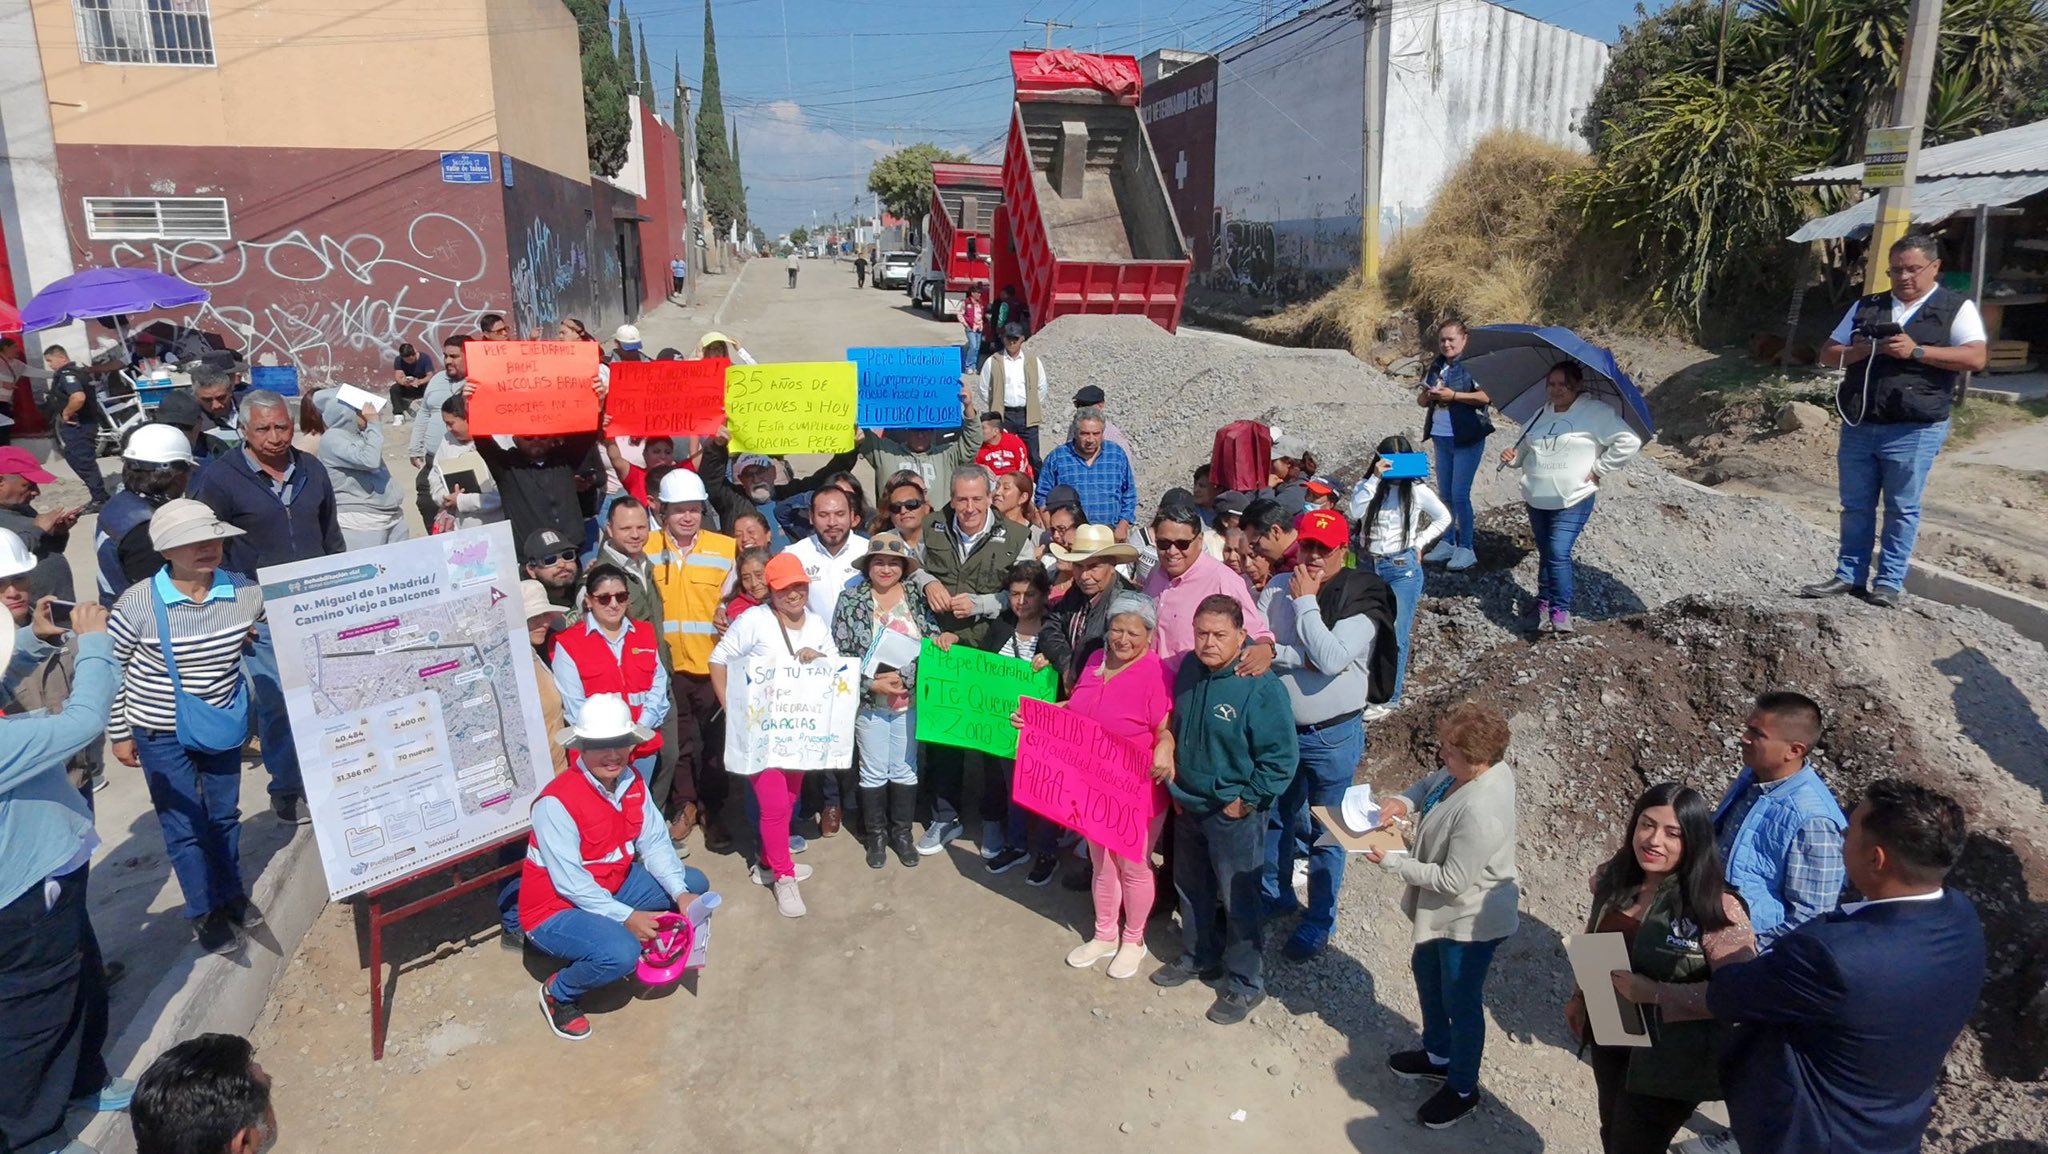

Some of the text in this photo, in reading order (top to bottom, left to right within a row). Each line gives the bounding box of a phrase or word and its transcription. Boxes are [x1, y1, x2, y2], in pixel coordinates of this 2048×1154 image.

[497, 376, 552, 392] NICOLAS
[770, 377, 803, 390] AÑOS
[811, 379, 828, 392] DE
[923, 390, 938, 399] un
[495, 400, 545, 415] GRACIAS
[788, 421, 851, 432] CUMPLIENDO
[743, 437, 799, 451] GRACIAS
[808, 435, 840, 448] PEPE
[293, 603, 313, 614] Av.
[314, 591, 357, 607] Miguel
[359, 589, 374, 599] de
[376, 586, 388, 596] la
[389, 576, 430, 592] Madrid
[295, 609, 344, 627] Camino
[345, 601, 378, 615] Viejo
[389, 587, 441, 606] Balcones
[761, 718, 817, 731] GRACIAS
[943, 713, 993, 745] Zona
[1023, 700, 1086, 747] GRACIAS
[1090, 724, 1119, 763] POR
[335, 738, 366, 749] habitantes
[397, 746, 434, 762] 70 nuevas
[1082, 779, 1139, 847] TODOS
